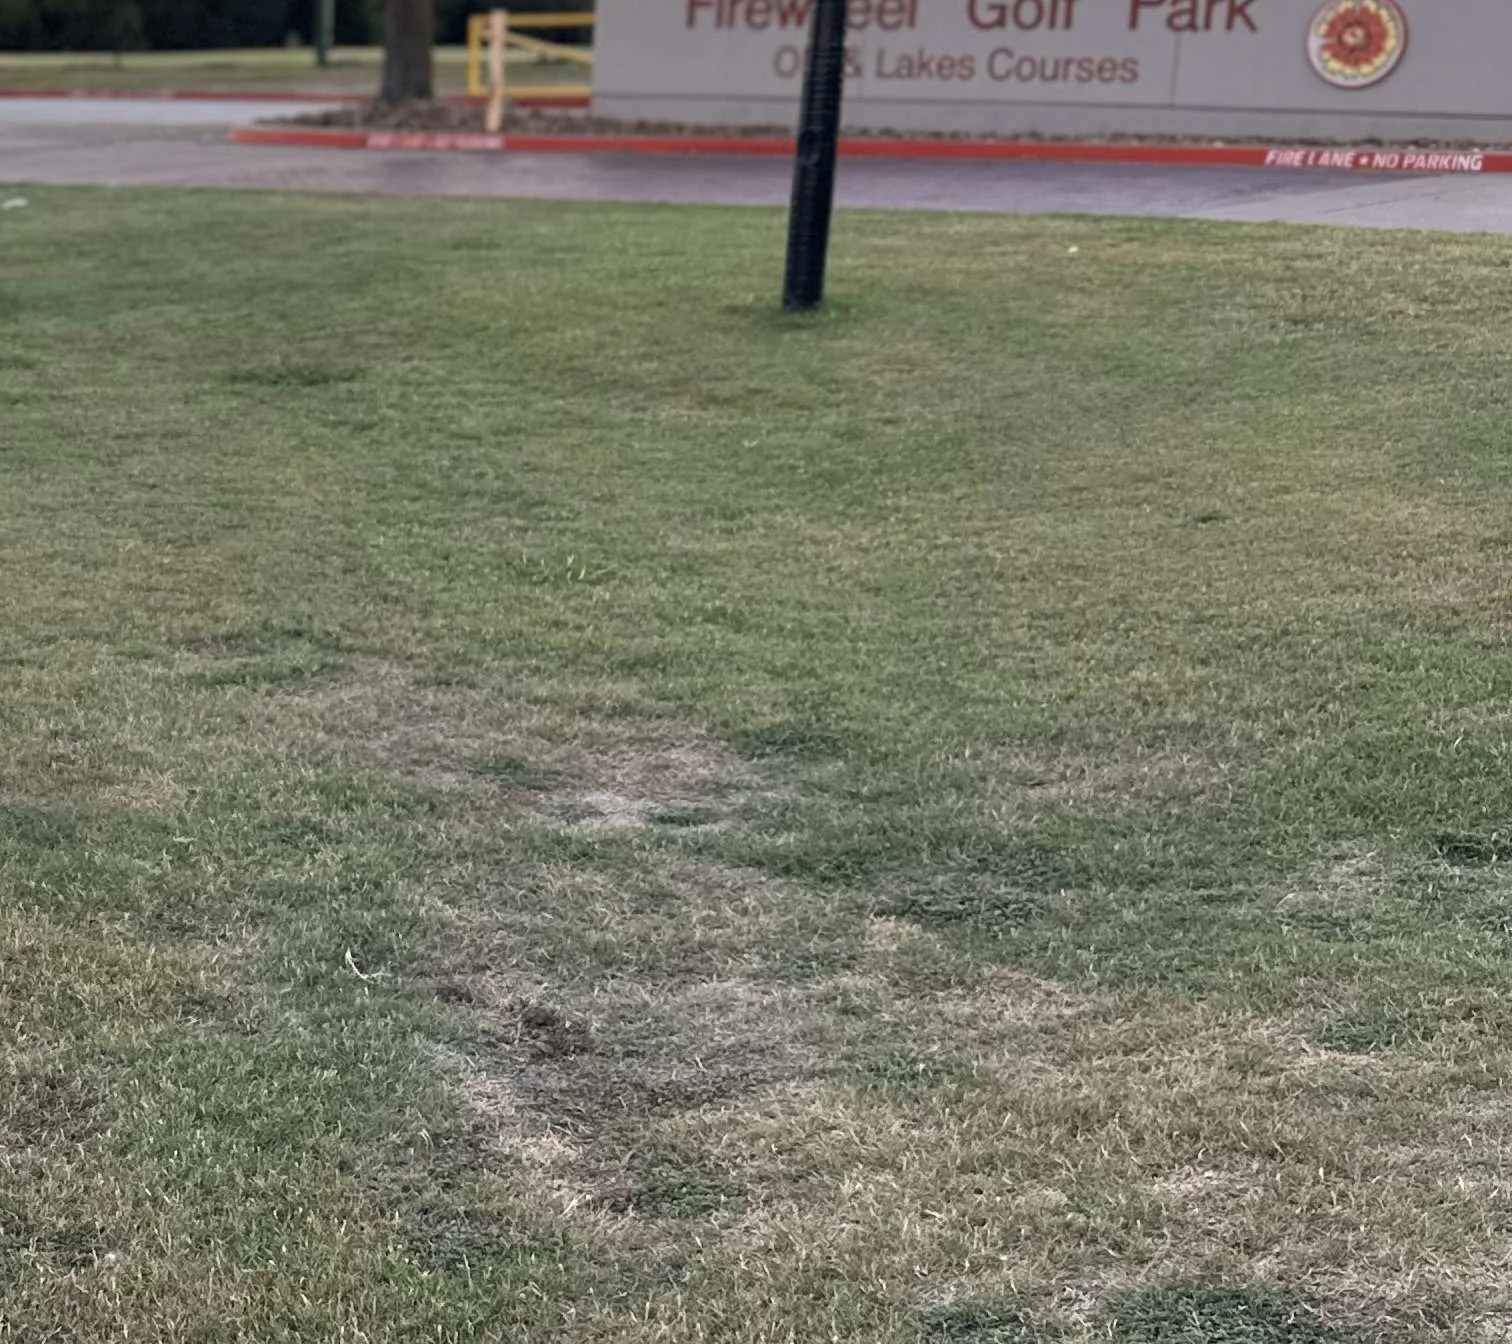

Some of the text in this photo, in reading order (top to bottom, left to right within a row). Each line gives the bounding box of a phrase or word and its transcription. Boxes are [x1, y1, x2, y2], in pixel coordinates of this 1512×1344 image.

[876, 47, 976, 81] Lakes
[986, 46, 1140, 84] Courses
[1265, 150, 1304, 166] FIRE
[1372, 153, 1399, 168] NO
[1402, 154, 1483, 171] PARKING
